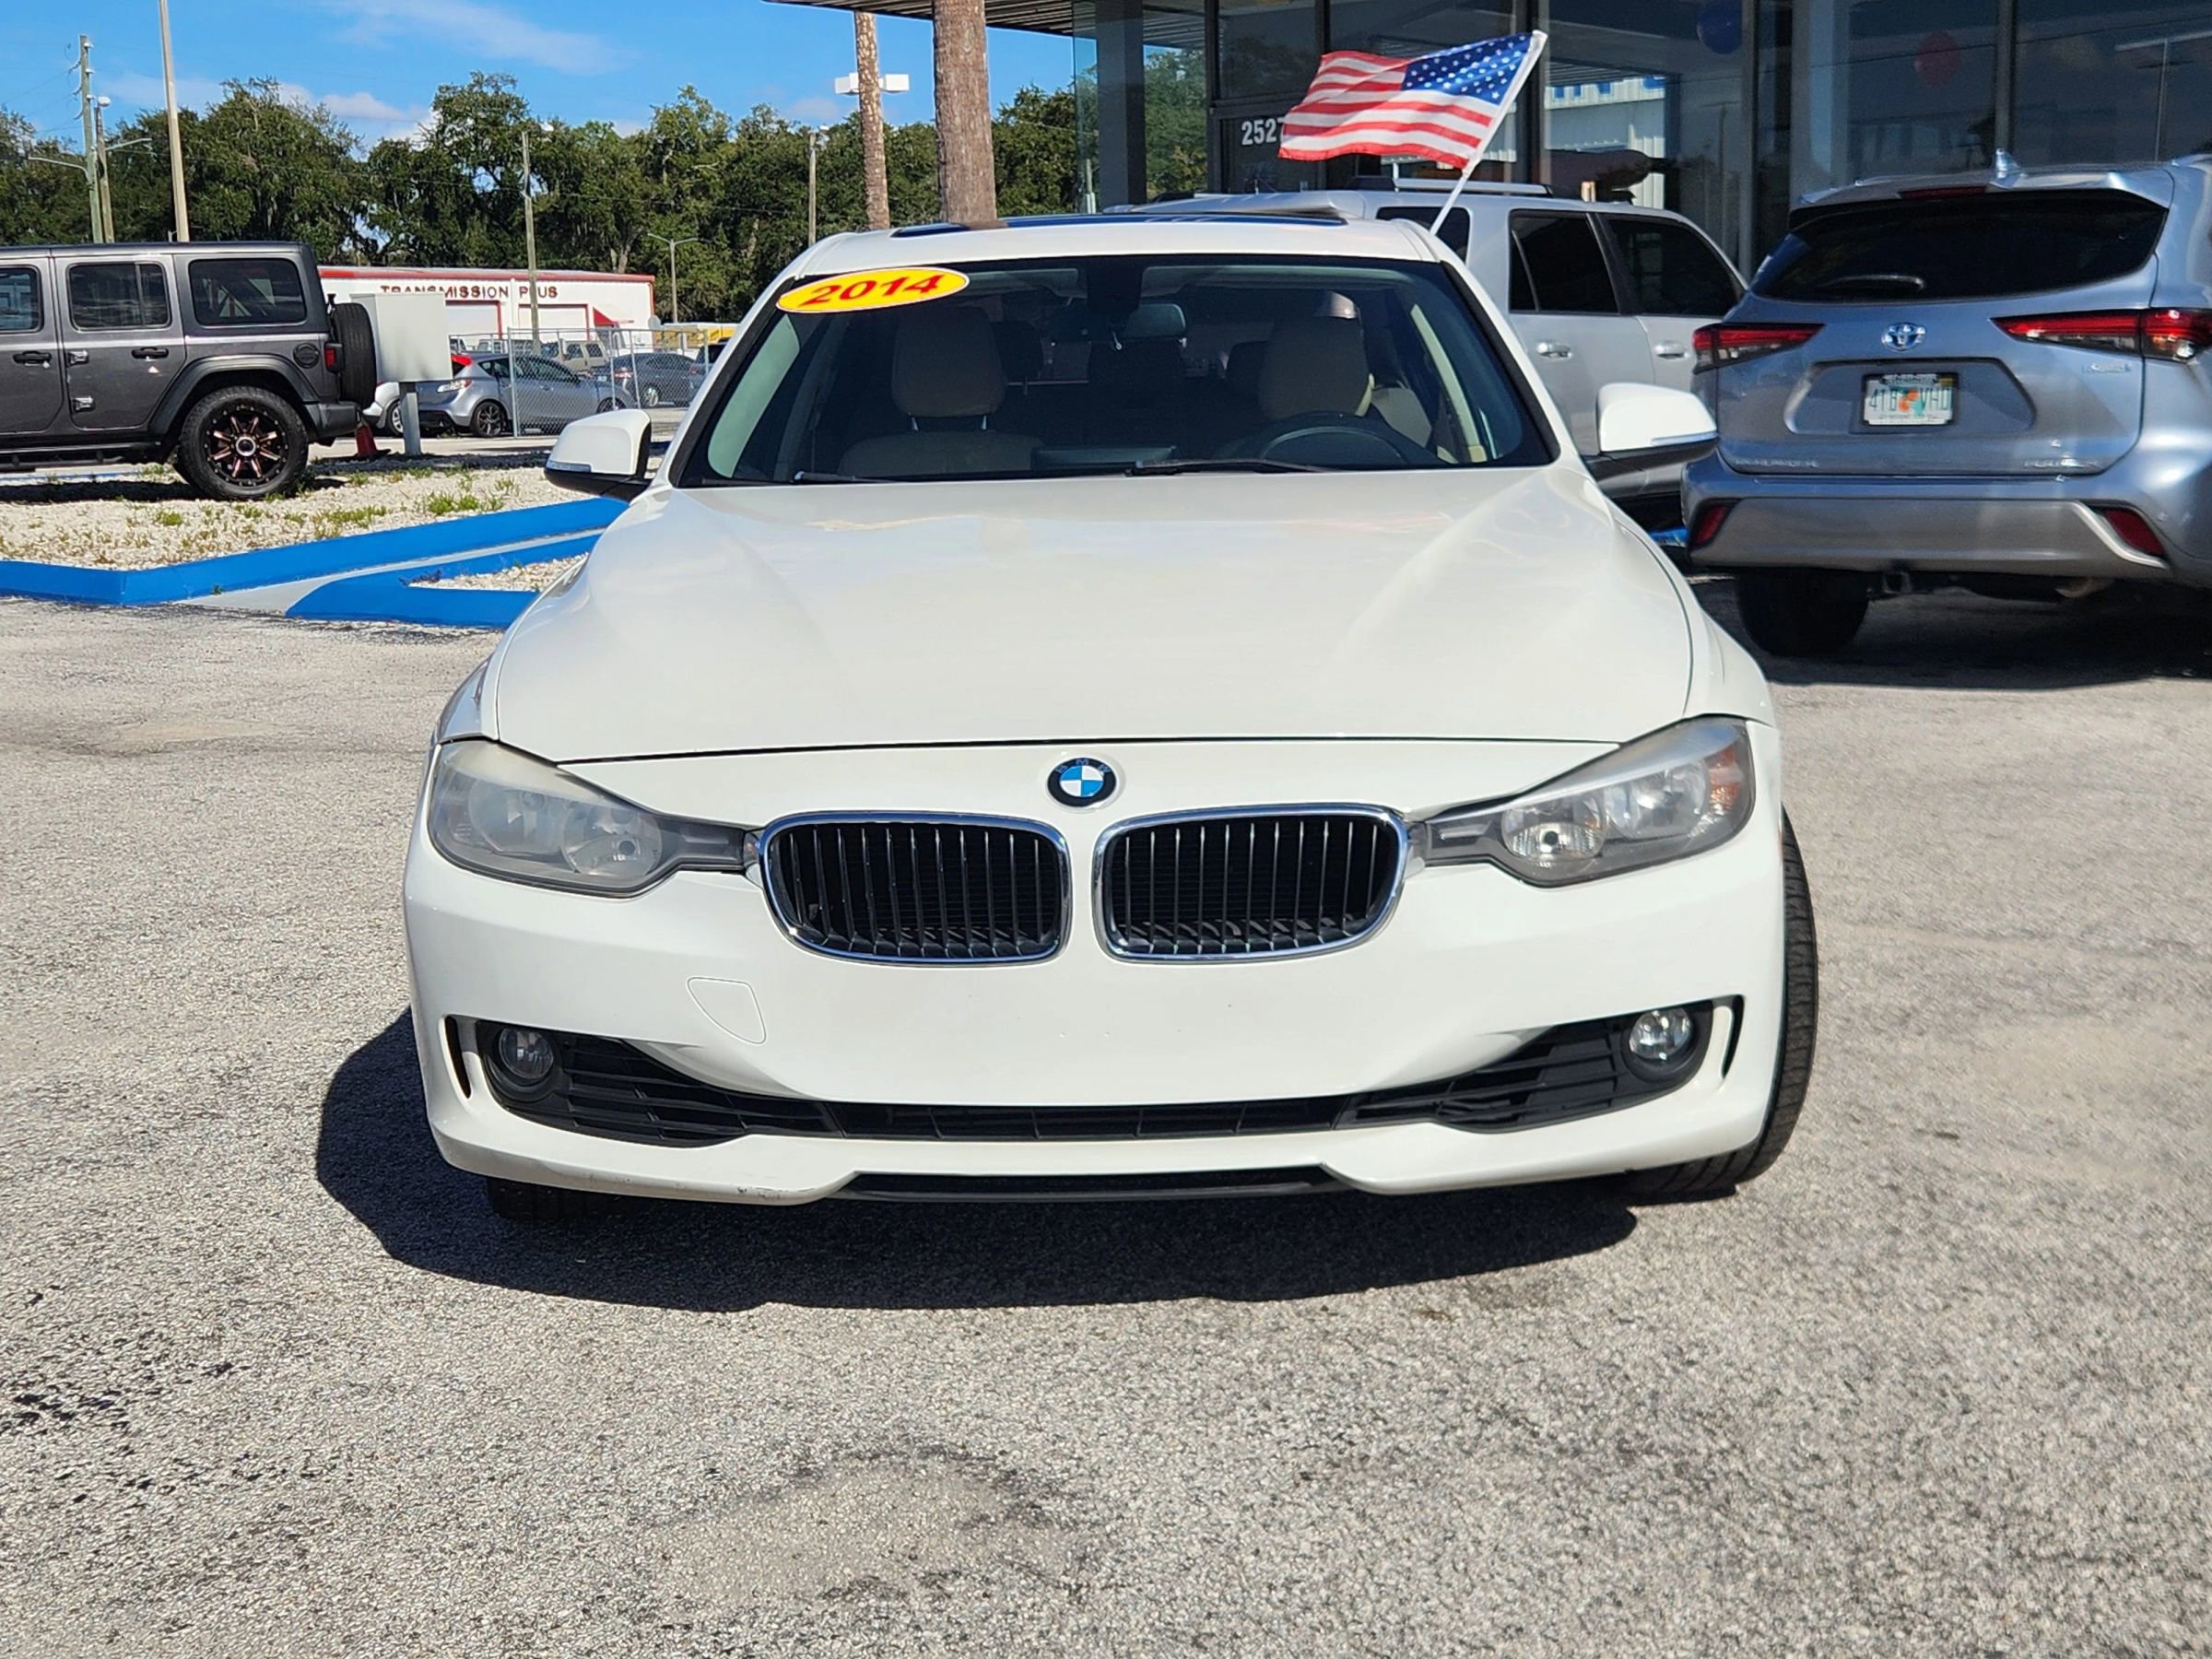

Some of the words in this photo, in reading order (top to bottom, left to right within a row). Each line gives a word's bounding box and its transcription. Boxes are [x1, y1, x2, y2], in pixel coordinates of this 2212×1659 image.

[519, 286, 559, 299] PUS
[797, 274, 945, 308] 2014
[1054, 758, 1112, 774] BMW
